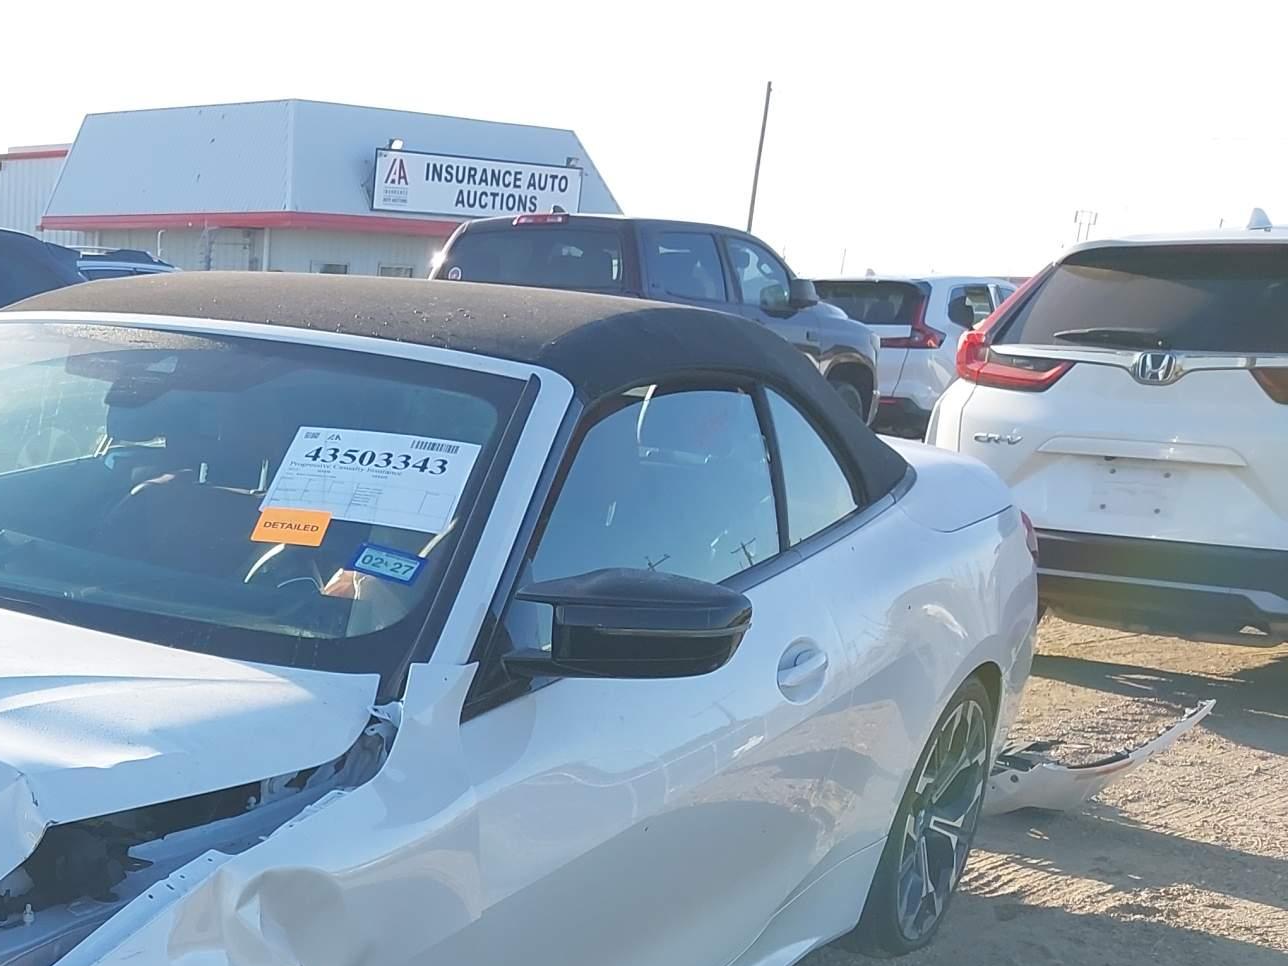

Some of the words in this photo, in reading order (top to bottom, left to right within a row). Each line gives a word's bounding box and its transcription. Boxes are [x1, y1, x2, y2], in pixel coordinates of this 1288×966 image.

[425, 162, 523, 189] INSURANCE
[526, 172, 569, 193] AUTO
[454, 189, 538, 213] AUCTIONS
[974, 432, 1023, 445] CR-V
[304, 446, 448, 475] 43503343
[263, 521, 319, 533] DETAILED
